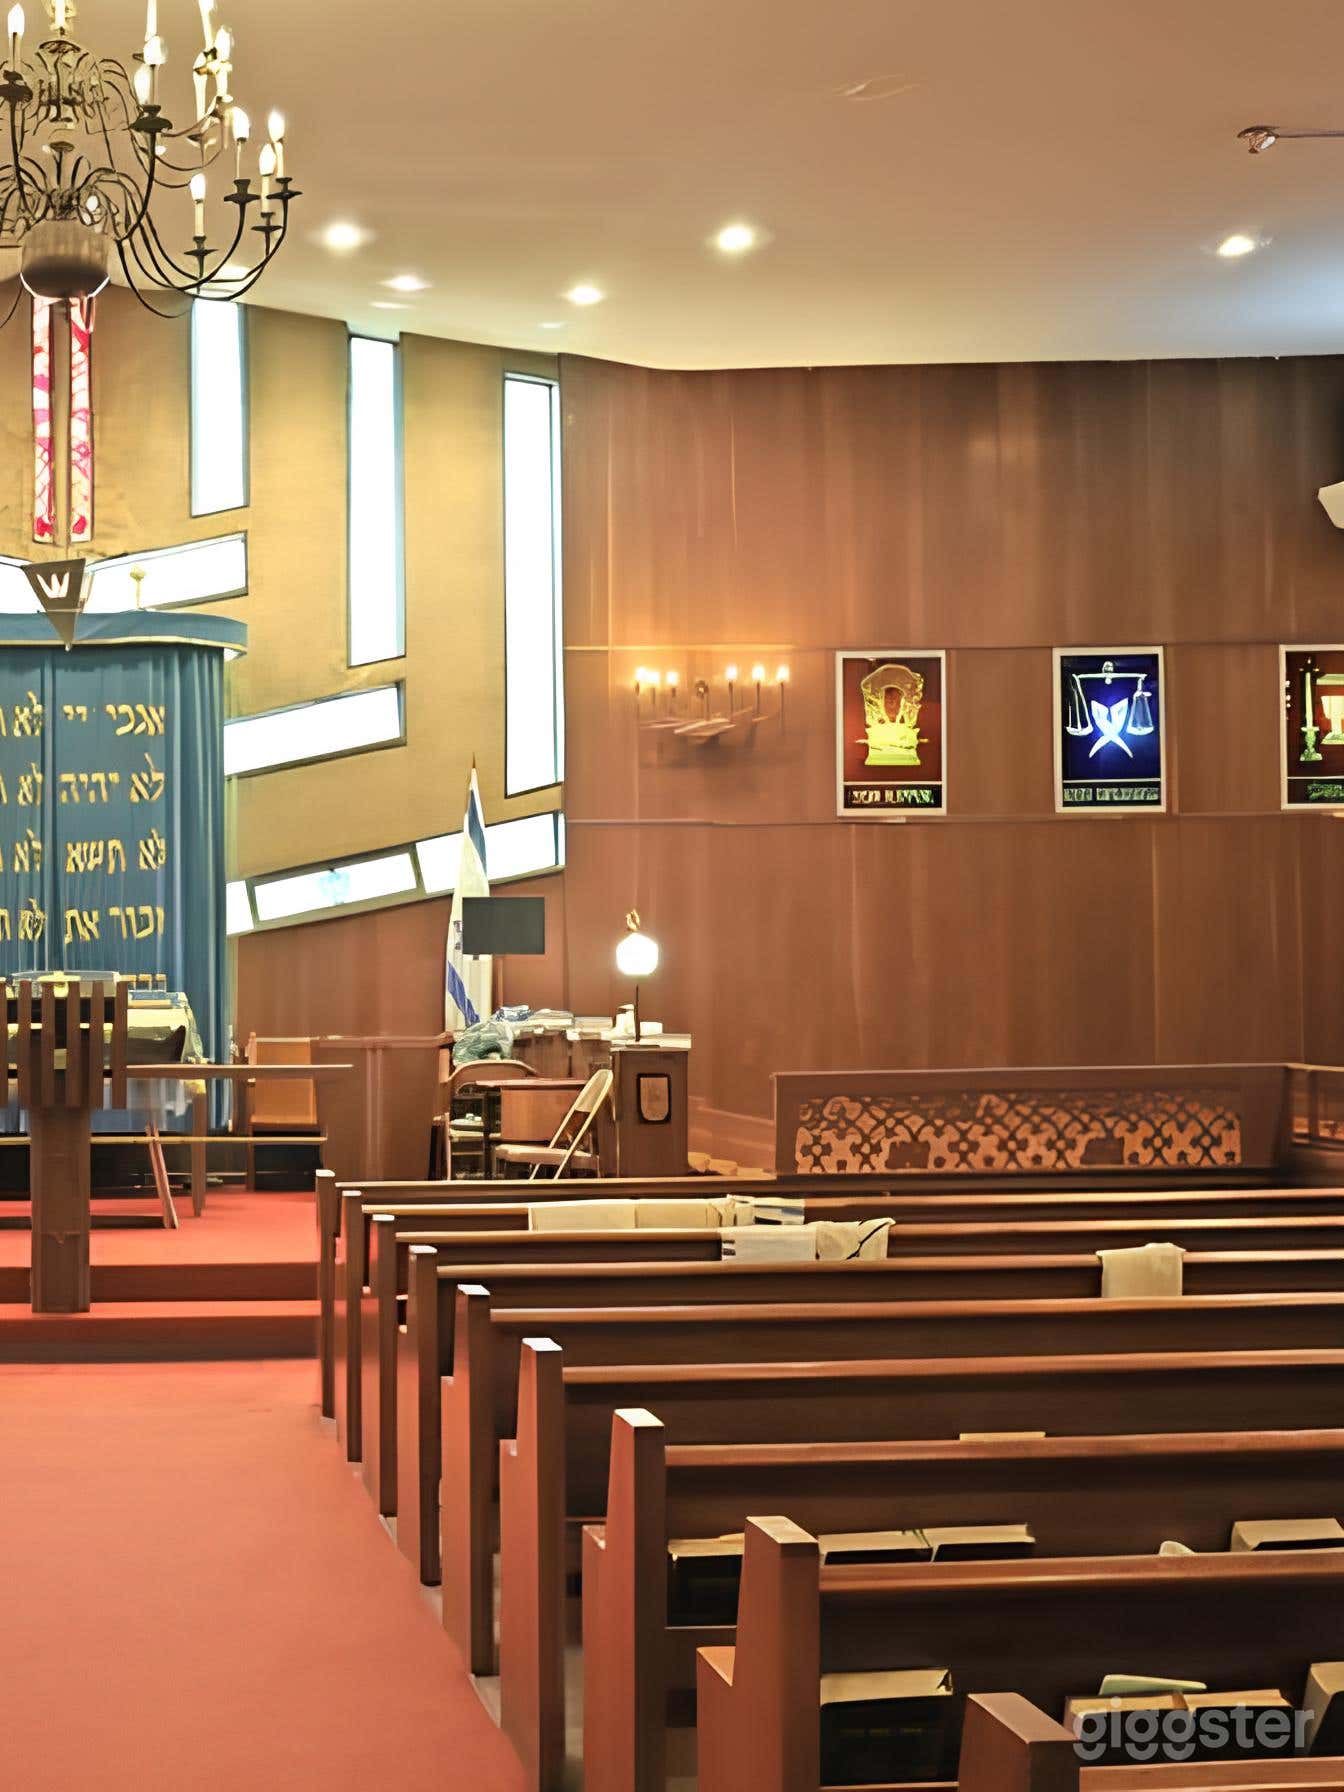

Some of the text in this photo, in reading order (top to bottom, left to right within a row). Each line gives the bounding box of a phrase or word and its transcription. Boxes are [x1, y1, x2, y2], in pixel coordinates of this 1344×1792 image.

[12, 690, 44, 737] לא
[16, 762, 45, 806] לא
[58, 754, 165, 804] לא יהיה
[12, 829, 43, 873] לא
[138, 829, 167, 870] לא
[63, 908, 100, 945] את
